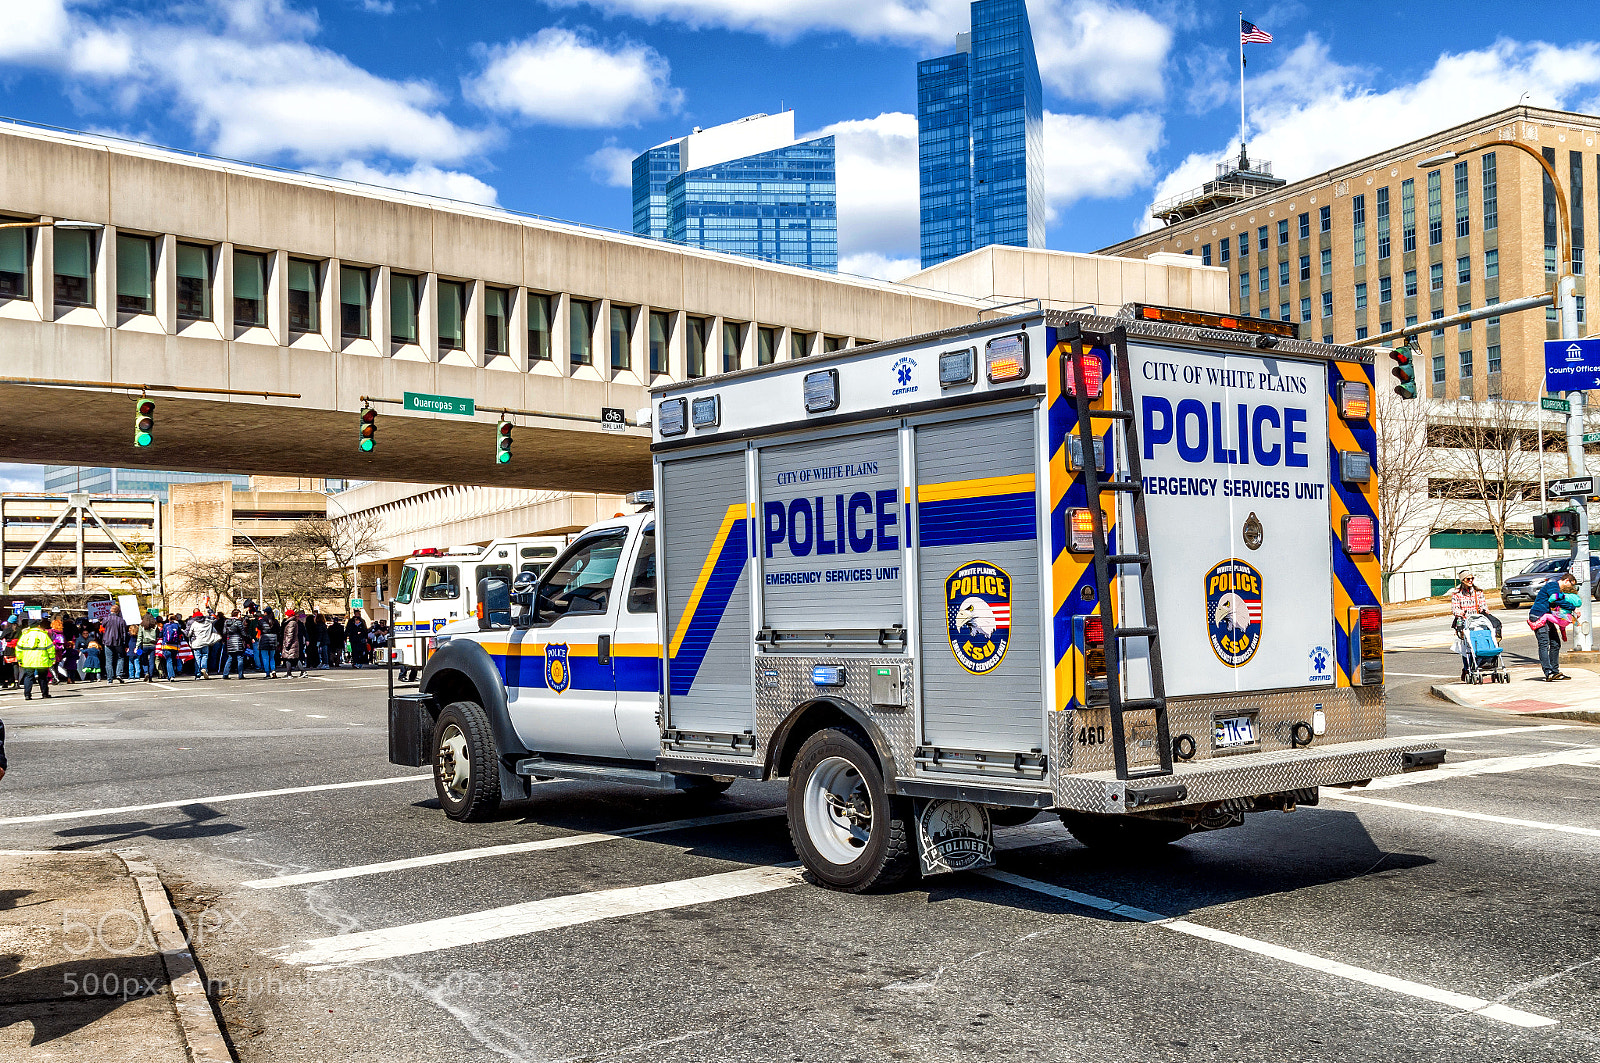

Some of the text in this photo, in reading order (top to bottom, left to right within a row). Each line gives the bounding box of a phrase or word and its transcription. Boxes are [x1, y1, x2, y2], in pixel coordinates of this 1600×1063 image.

[1142, 361, 1307, 394] CITY OF WHITE PLAINS
[1548, 366, 1575, 374] County
[892, 386, 918, 395] CERTIFIED
[413, 396, 453, 411] Quarropas
[1141, 395, 1309, 467] POLICE
[777, 461, 878, 485] CITY OF WHITE PLAINS
[1224, 479, 1290, 498] SERVICES
[1295, 482, 1324, 500] UNIT
[1573, 482, 1588, 490] WAY
[764, 489, 899, 558] POLICE
[766, 567, 899, 585] EMERGENCY SERVICES UNIT
[959, 567, 997, 578] WHITE PLAINS
[950, 575, 1007, 600] POLICE
[1209, 573, 1260, 595] POLICE
[93, 609, 110, 618] KIDS
[548, 648, 566, 658] POLICE
[962, 640, 996, 660] ESU
[1220, 634, 1250, 654] ESU
[951, 638, 1007, 671] EMERGENCY SERVICES UNIT
[1078, 726, 1105, 746] 460
[1223, 718, 1253, 741] TK-1
[931, 840, 985, 860] PROLINER
